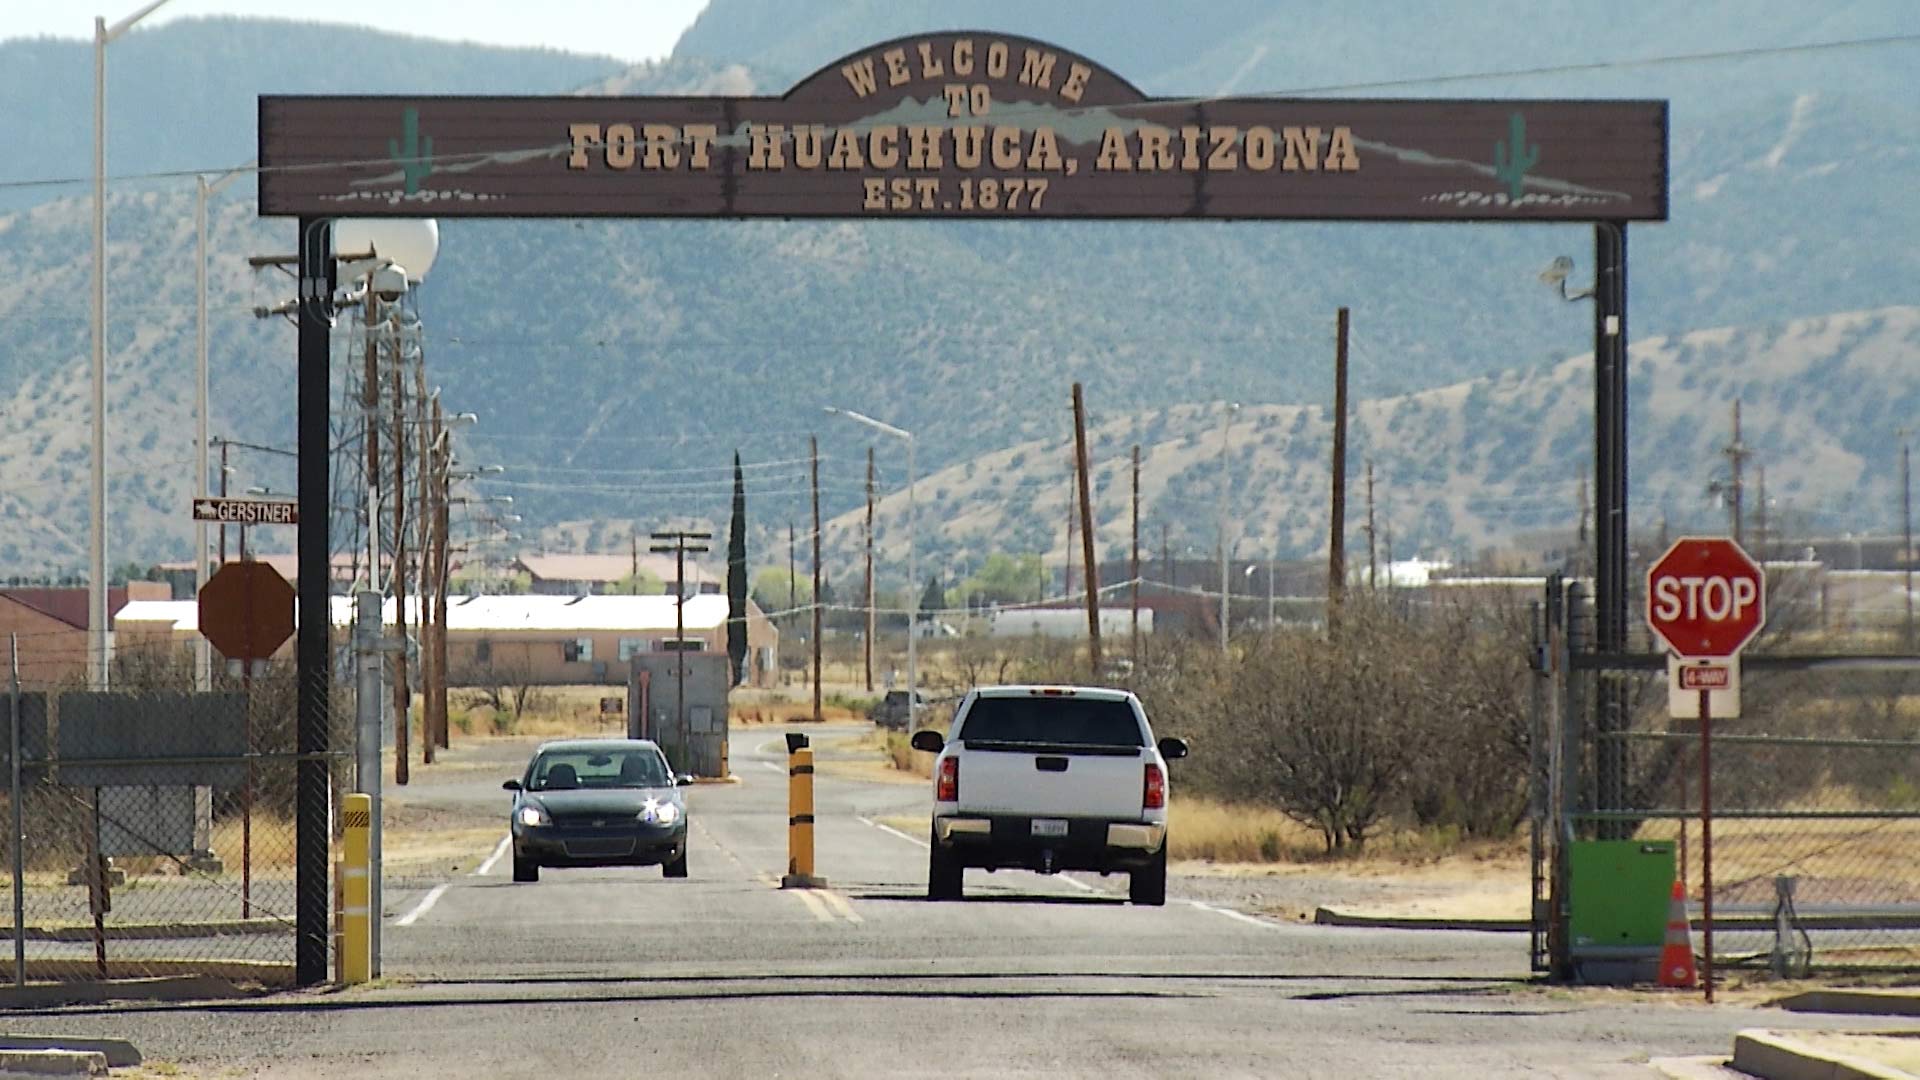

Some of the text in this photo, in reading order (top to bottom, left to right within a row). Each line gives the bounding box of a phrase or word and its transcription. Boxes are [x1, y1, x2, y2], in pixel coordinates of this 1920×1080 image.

[841, 38, 1092, 103] WELCOME
[944, 83, 990, 117] TO
[568, 123, 1360, 176] FORT HUACHUCA, ARIZONA
[218, 502, 291, 522] GERSTNER
[1656, 576, 1756, 621] STOP
[1688, 670, 1727, 685] 4-WAY
